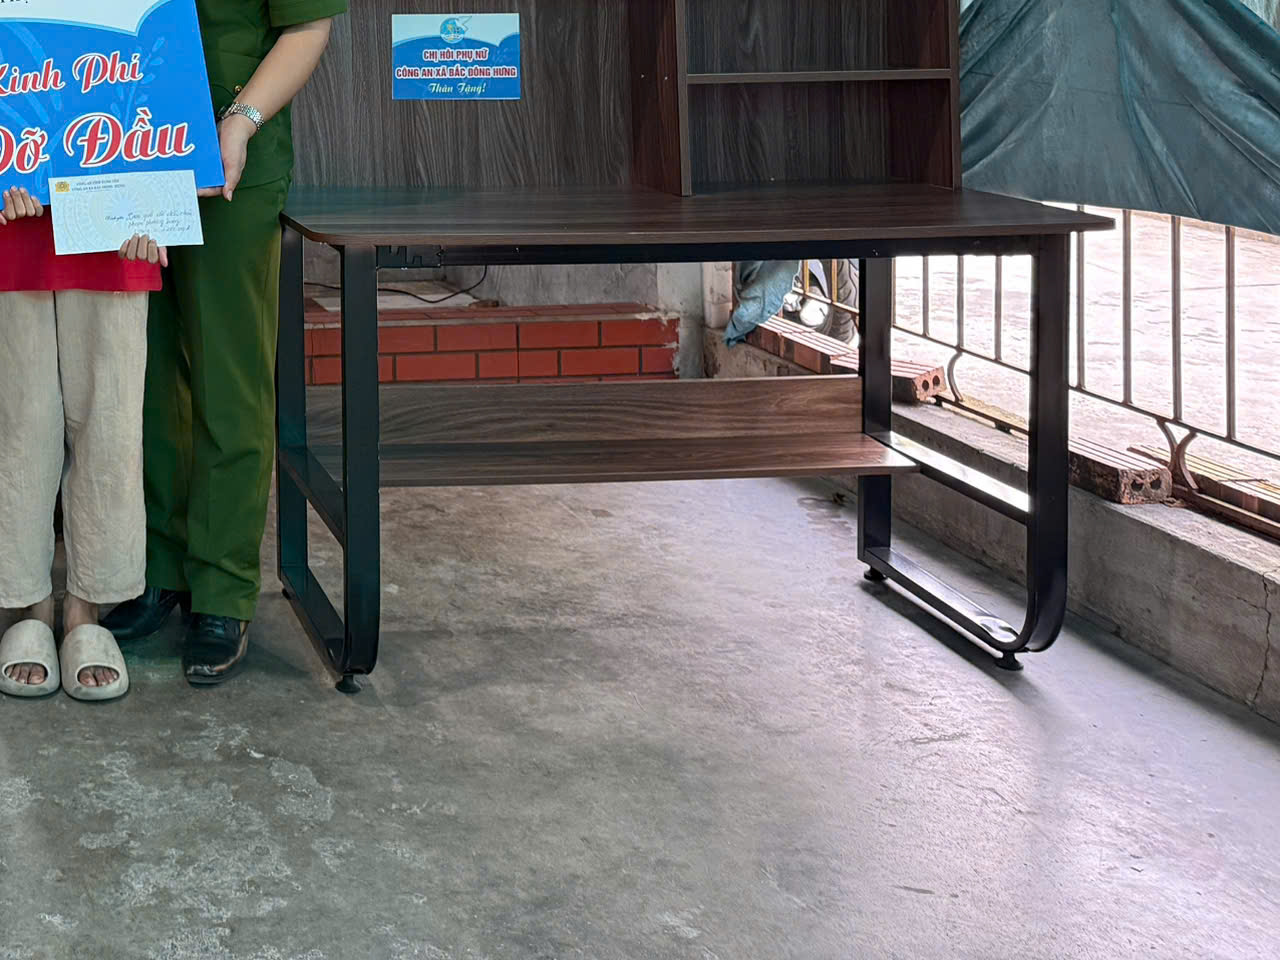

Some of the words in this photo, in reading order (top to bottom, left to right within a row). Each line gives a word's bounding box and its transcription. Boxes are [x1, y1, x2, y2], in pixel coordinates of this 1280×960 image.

[456, 49, 473, 62] PHỤ
[72, 50, 144, 93] Phí
[396, 66, 419, 79] CÔNG
[421, 67, 433, 79] AN
[63, 107, 195, 168] Đầu
